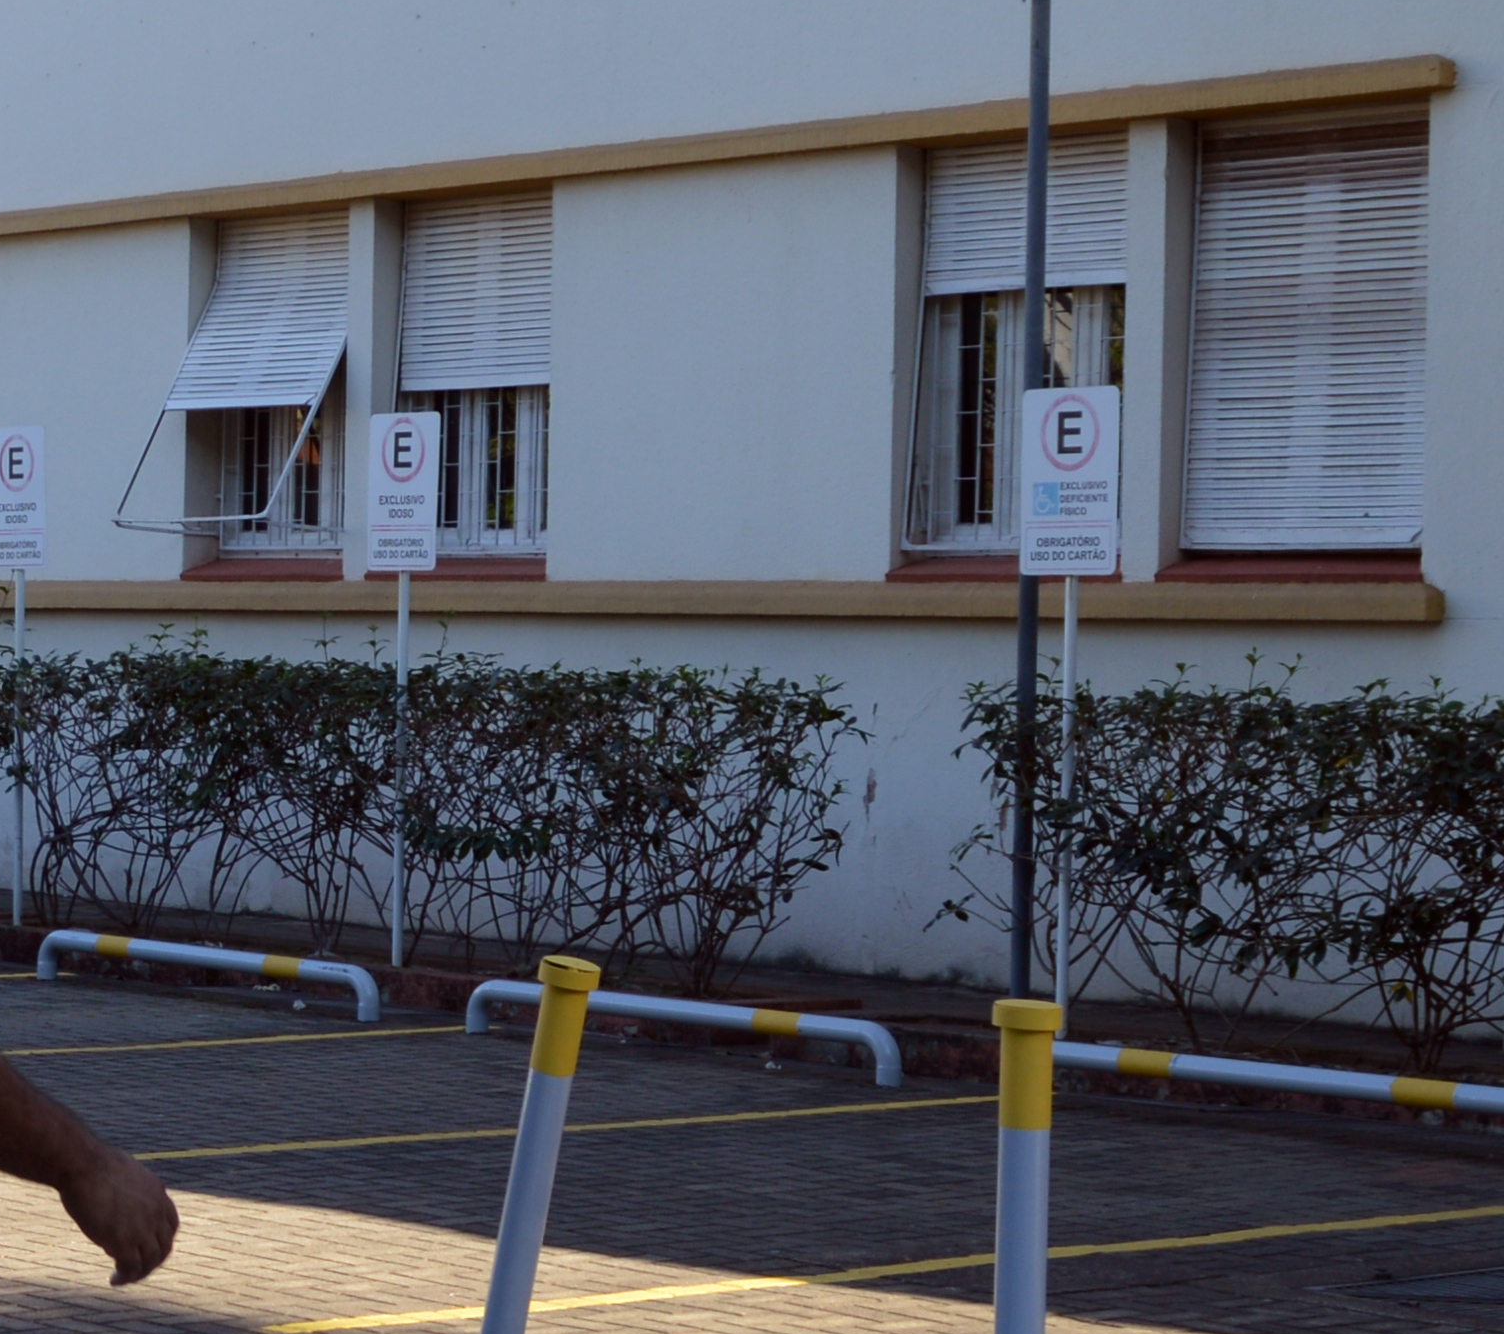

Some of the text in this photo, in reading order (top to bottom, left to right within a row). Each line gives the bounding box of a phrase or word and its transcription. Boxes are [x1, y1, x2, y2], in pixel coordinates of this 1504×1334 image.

[1056, 410, 1083, 455] E
[393, 431, 413, 468] E
[8, 446, 24, 480] E
[1059, 480, 1108, 490] EXCLUSIVO
[378, 495, 425, 505] EXCLUSIVO
[1059, 493, 1109, 503] DEFICIENTE
[388, 508, 414, 518] IDOSO
[1059, 505, 1087, 516] FÍSICO
[5, 514, 28, 524] IDOSO
[1036, 534, 1101, 548] OBRIGATÓRIO
[373, 548, 429, 559] USO DO CARTÃO
[1030, 548, 1107, 561] USO DO CARTÃO
